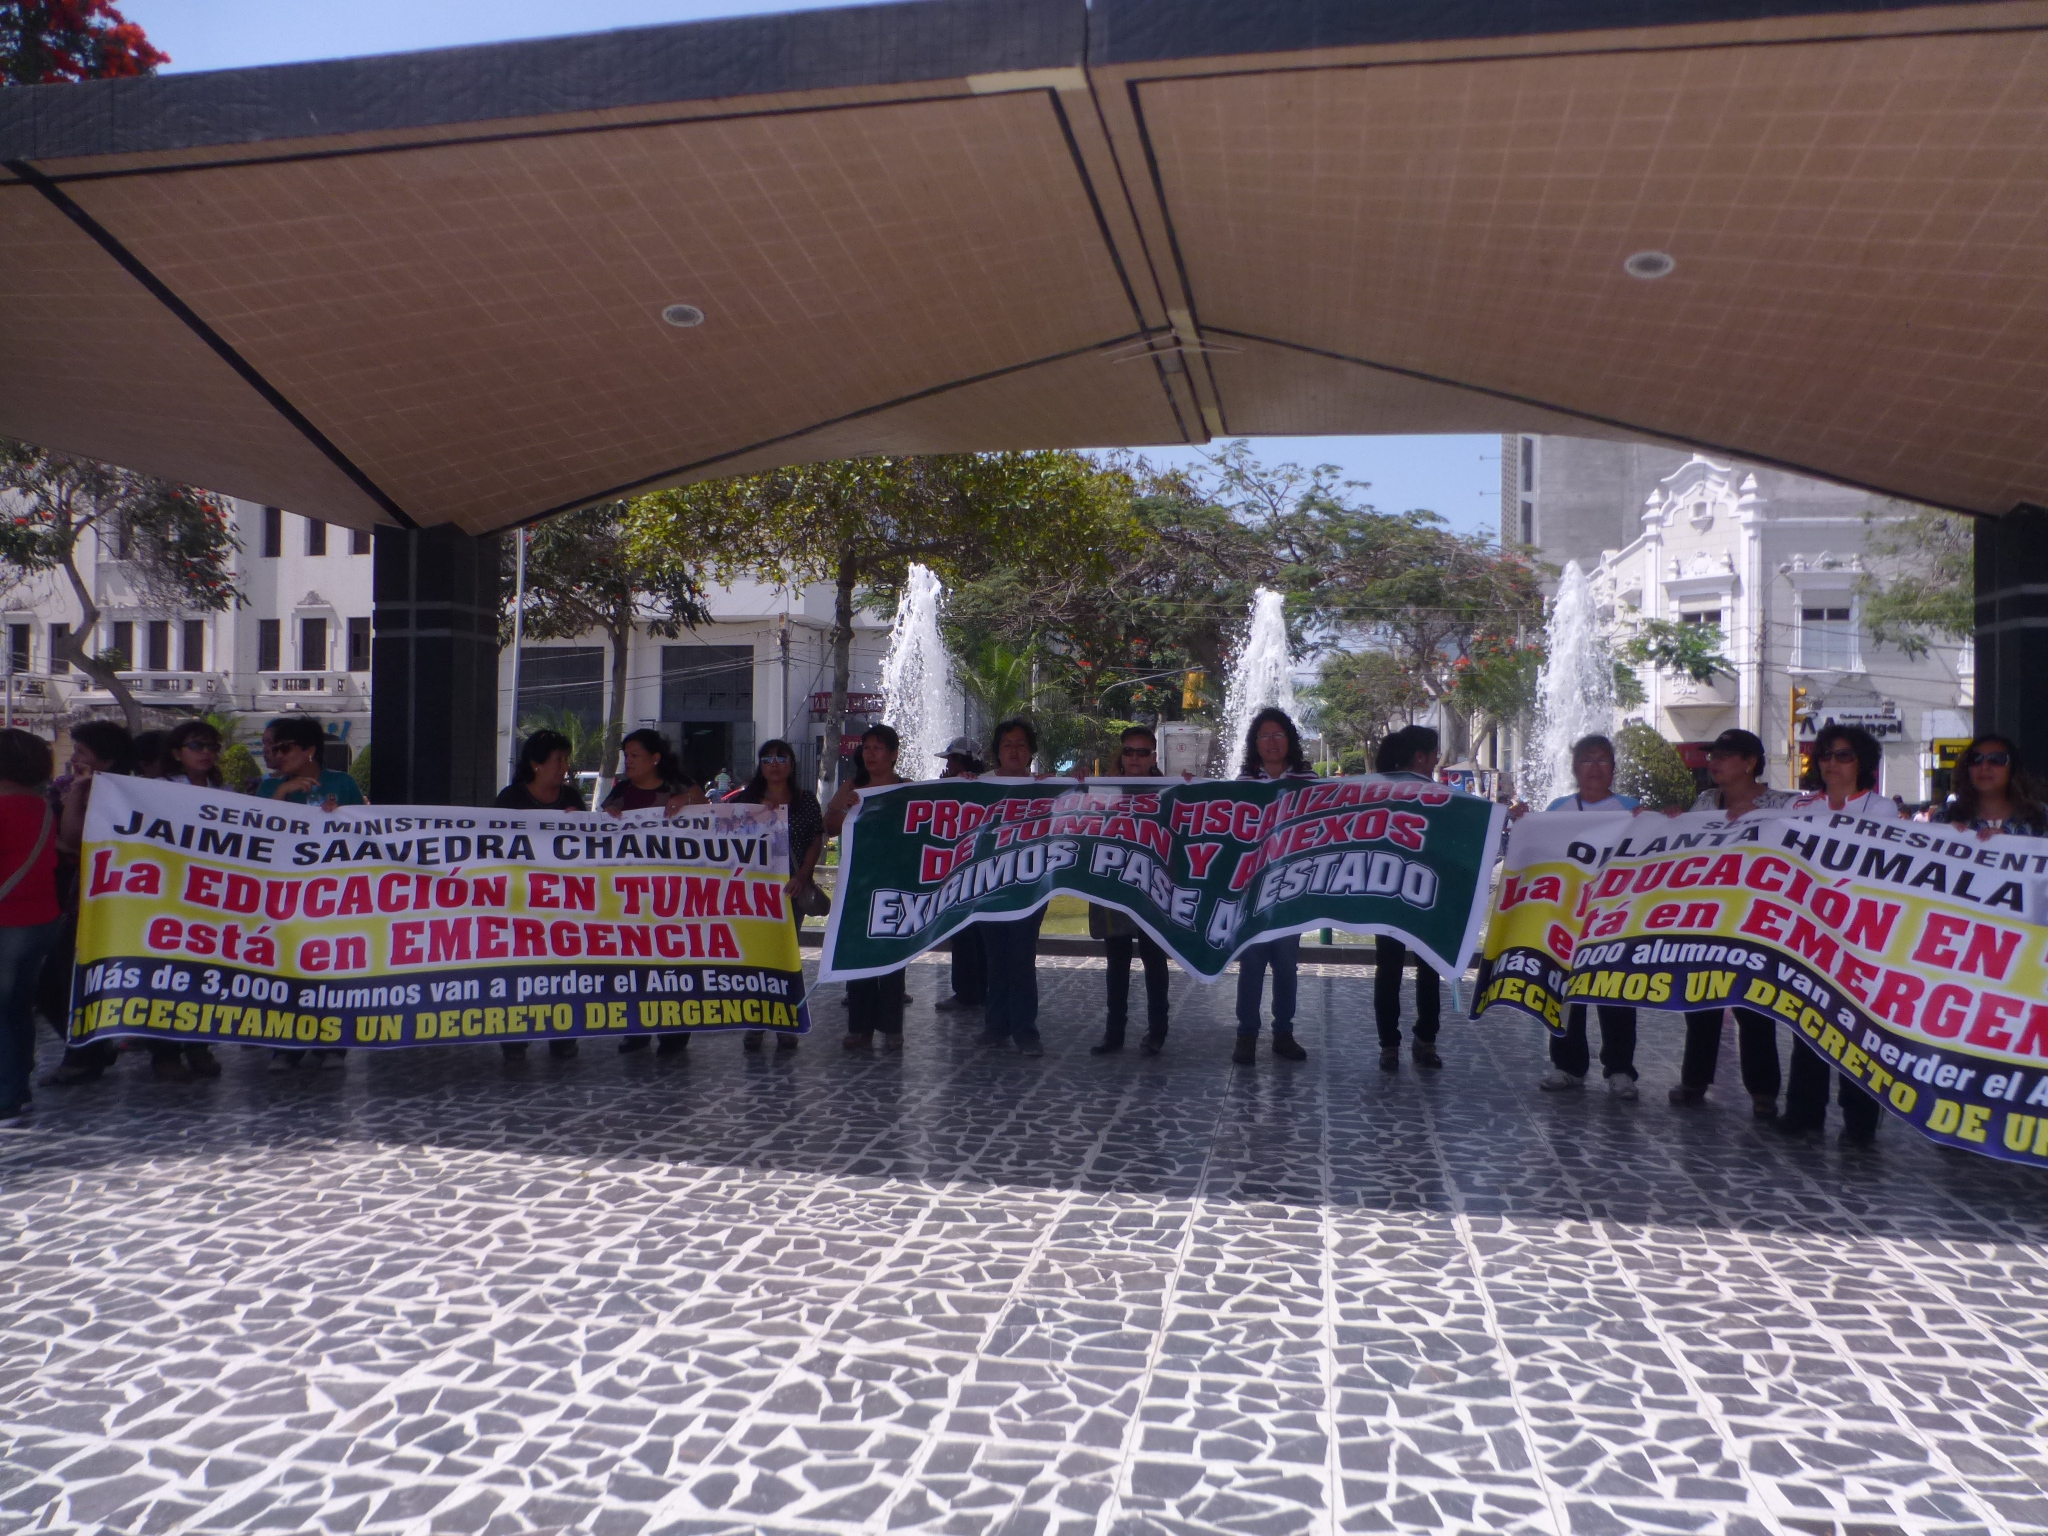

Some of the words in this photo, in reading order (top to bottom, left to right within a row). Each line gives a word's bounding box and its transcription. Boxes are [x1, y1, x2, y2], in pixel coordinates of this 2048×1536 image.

[1823, 716, 1902, 737] Angel
[113, 810, 276, 864] JAIME
[292, 834, 536, 866] SAAVEDRA
[552, 832, 769, 866] CHANDUVÍ
[198, 804, 311, 836] SEÑOR
[322, 816, 476, 836] MINISTRO
[488, 818, 528, 831] DE
[539, 814, 712, 833] EDUCACIÓN
[903, 793, 1162, 841] PROFESORES
[1170, 781, 1452, 842] FISCALIZADOS
[919, 836, 976, 884] DE
[994, 811, 1172, 865] TUMÁN
[1185, 842, 1222, 879] Y
[1228, 808, 1430, 891] ANEXOS
[1781, 828, 2024, 913] HUMALA
[89, 849, 162, 898] La
[184, 864, 508, 921] EDUCACIÓN
[528, 872, 596, 911] EN
[615, 867, 784, 920] TUMÁN
[867, 840, 1079, 938] EXIGIMOS
[1089, 842, 1201, 932] PASE
[1253, 850, 1440, 917] ESTADO
[148, 917, 276, 968] está
[299, 936, 367, 971] en
[389, 916, 740, 966] EMERGENCIA
[1500, 875, 1561, 911] La
[1912, 911, 2023, 980] EN
[1548, 901, 1628, 960] etá
[1645, 902, 1720, 929] en
[84, 962, 141, 996] Más
[151, 965, 190, 991] de
[201, 968, 289, 1003] 3,000
[298, 983, 421, 1009] alumnos
[430, 977, 479, 1001] van
[490, 976, 507, 998] a
[517, 969, 605, 1002] perder
[614, 969, 637, 993] el
[647, 968, 694, 993] Año
[703, 969, 789, 996] Escolar
[71, 996, 342, 1041] ¡NECESITAMOS
[356, 1014, 404, 1042] UN
[415, 1003, 573, 1040] DECRETO
[586, 1001, 629, 1028] DE
[639, 999, 799, 1027] URGENCIA!
[1632, 939, 1767, 971] alumnos
[1776, 963, 1830, 1009] van
[1837, 1007, 1856, 1032] a
[1862, 1030, 1976, 1091] perder
[1982, 1071, 2024, 1101] el
[1476, 970, 1672, 1028] ¡NECEAMOS
[1684, 971, 1738, 1001] UN
[1744, 977, 1918, 1113] DECRETO
[1925, 1098, 1992, 1144] DE
